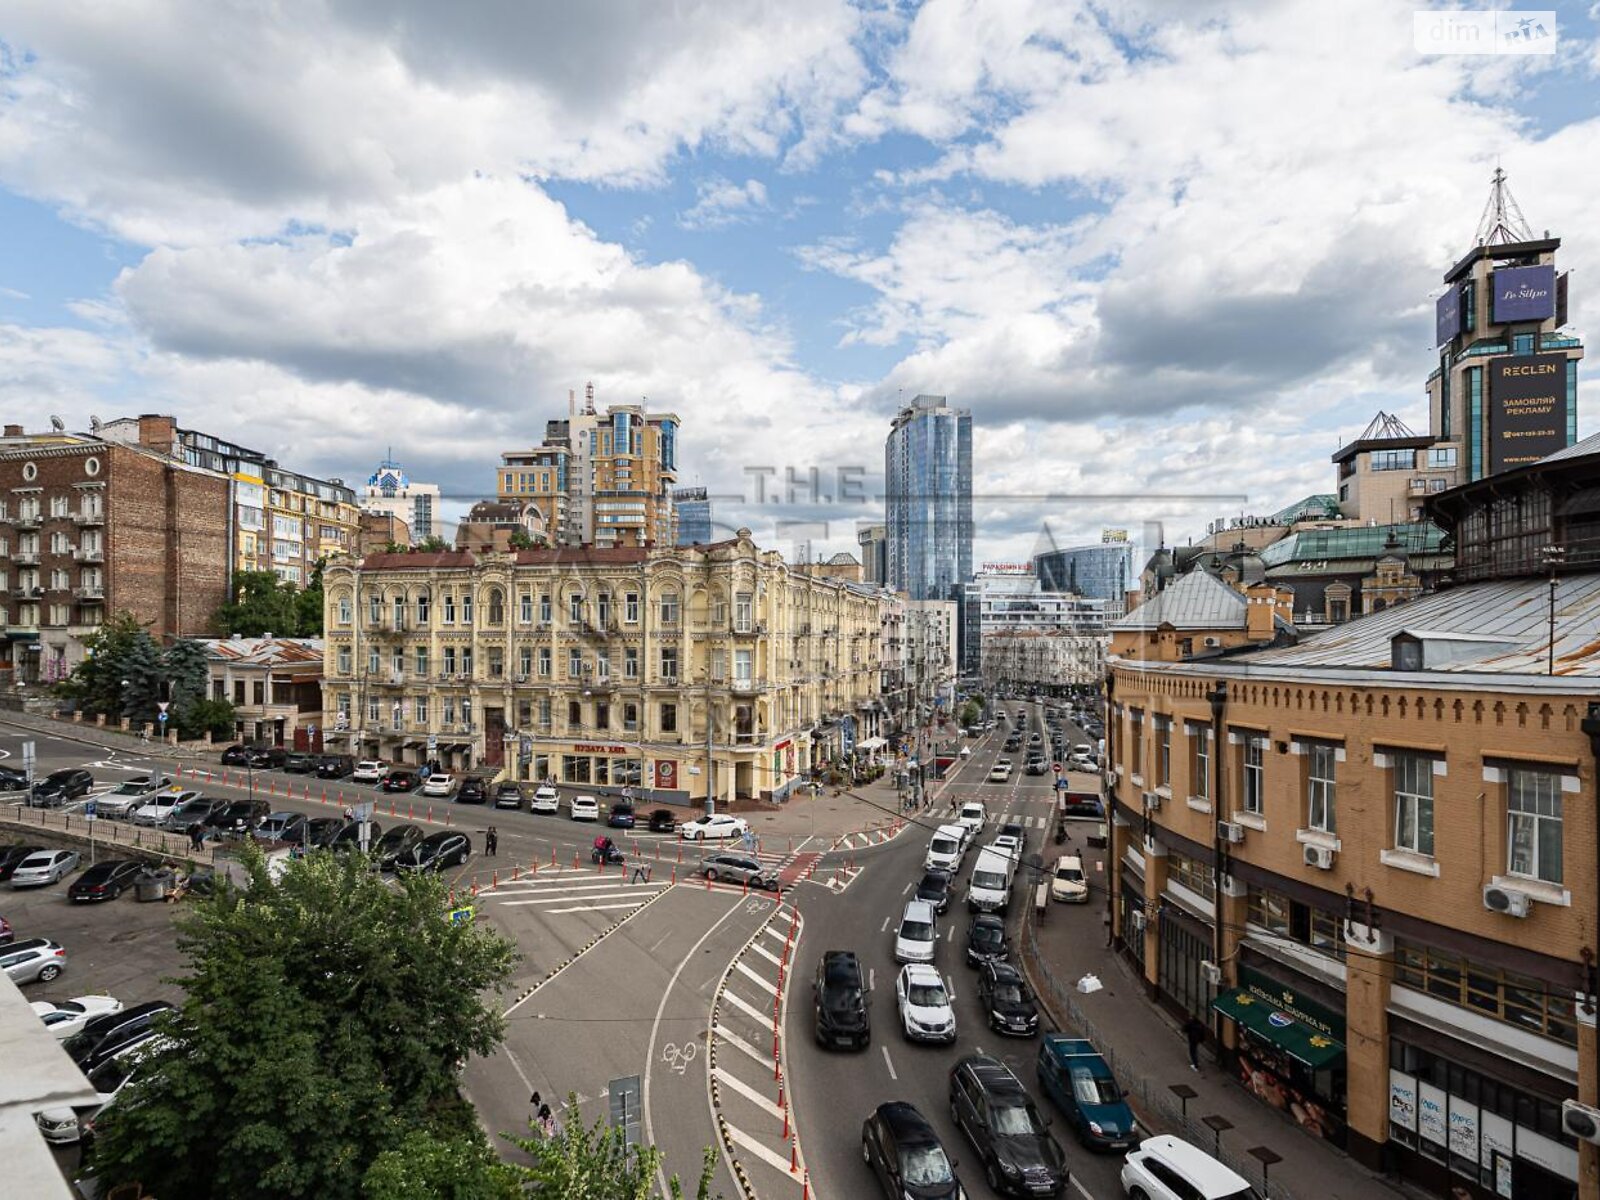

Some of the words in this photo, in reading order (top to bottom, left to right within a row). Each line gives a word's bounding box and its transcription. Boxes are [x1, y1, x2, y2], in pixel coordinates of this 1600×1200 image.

[1503, 364, 1556, 377] RECLEN
[1503, 396, 1556, 408] ЗАМОВЛЯЙ
[1506, 406, 1552, 415] РЕКЛАМУ
